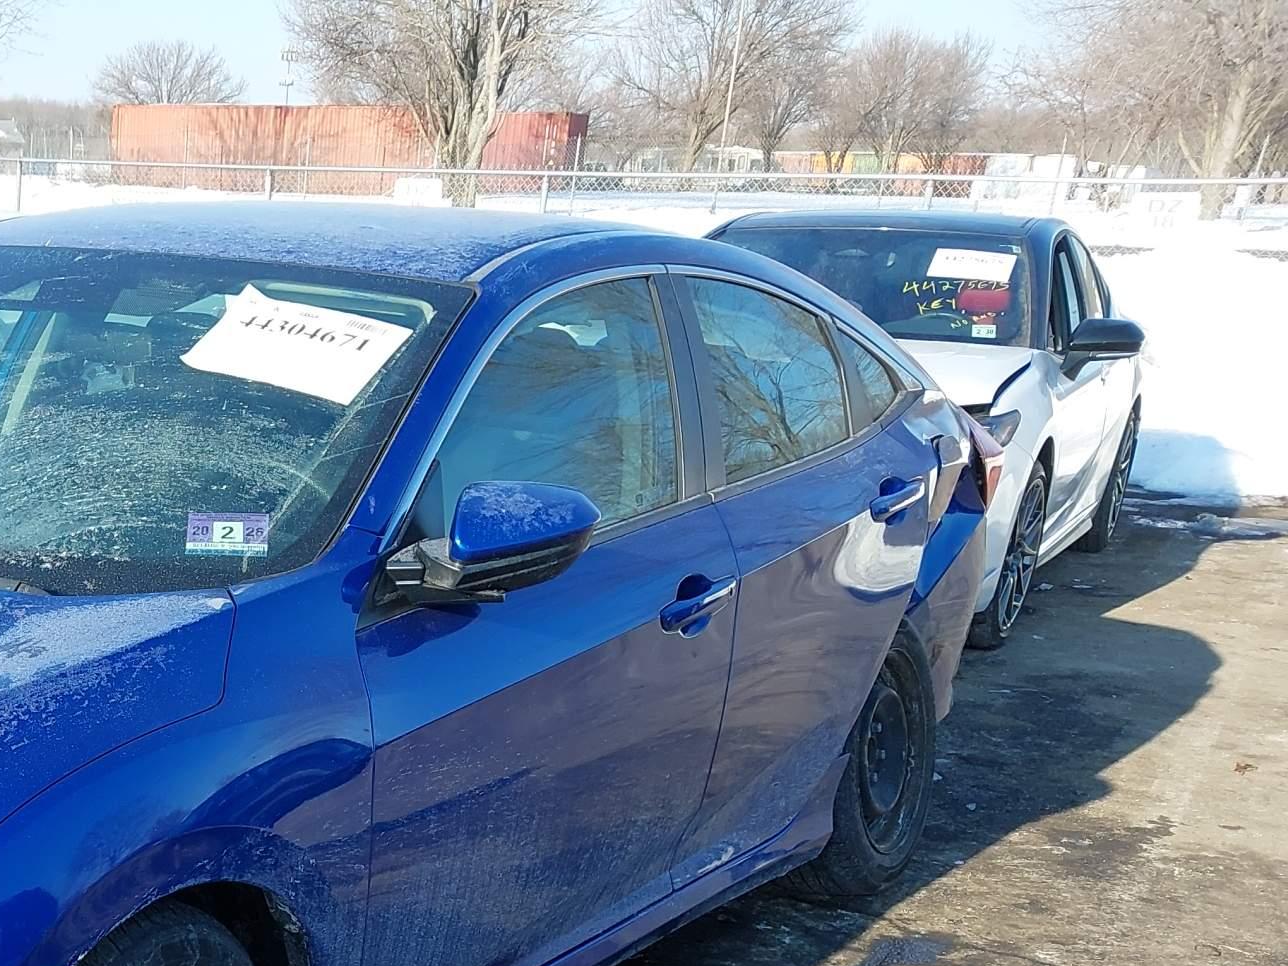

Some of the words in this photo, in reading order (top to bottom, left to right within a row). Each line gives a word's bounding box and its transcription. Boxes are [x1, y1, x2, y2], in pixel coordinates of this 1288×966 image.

[240, 315, 371, 351] 44304671
[192, 525, 209, 536] 20
[220, 525, 236, 539] 2
